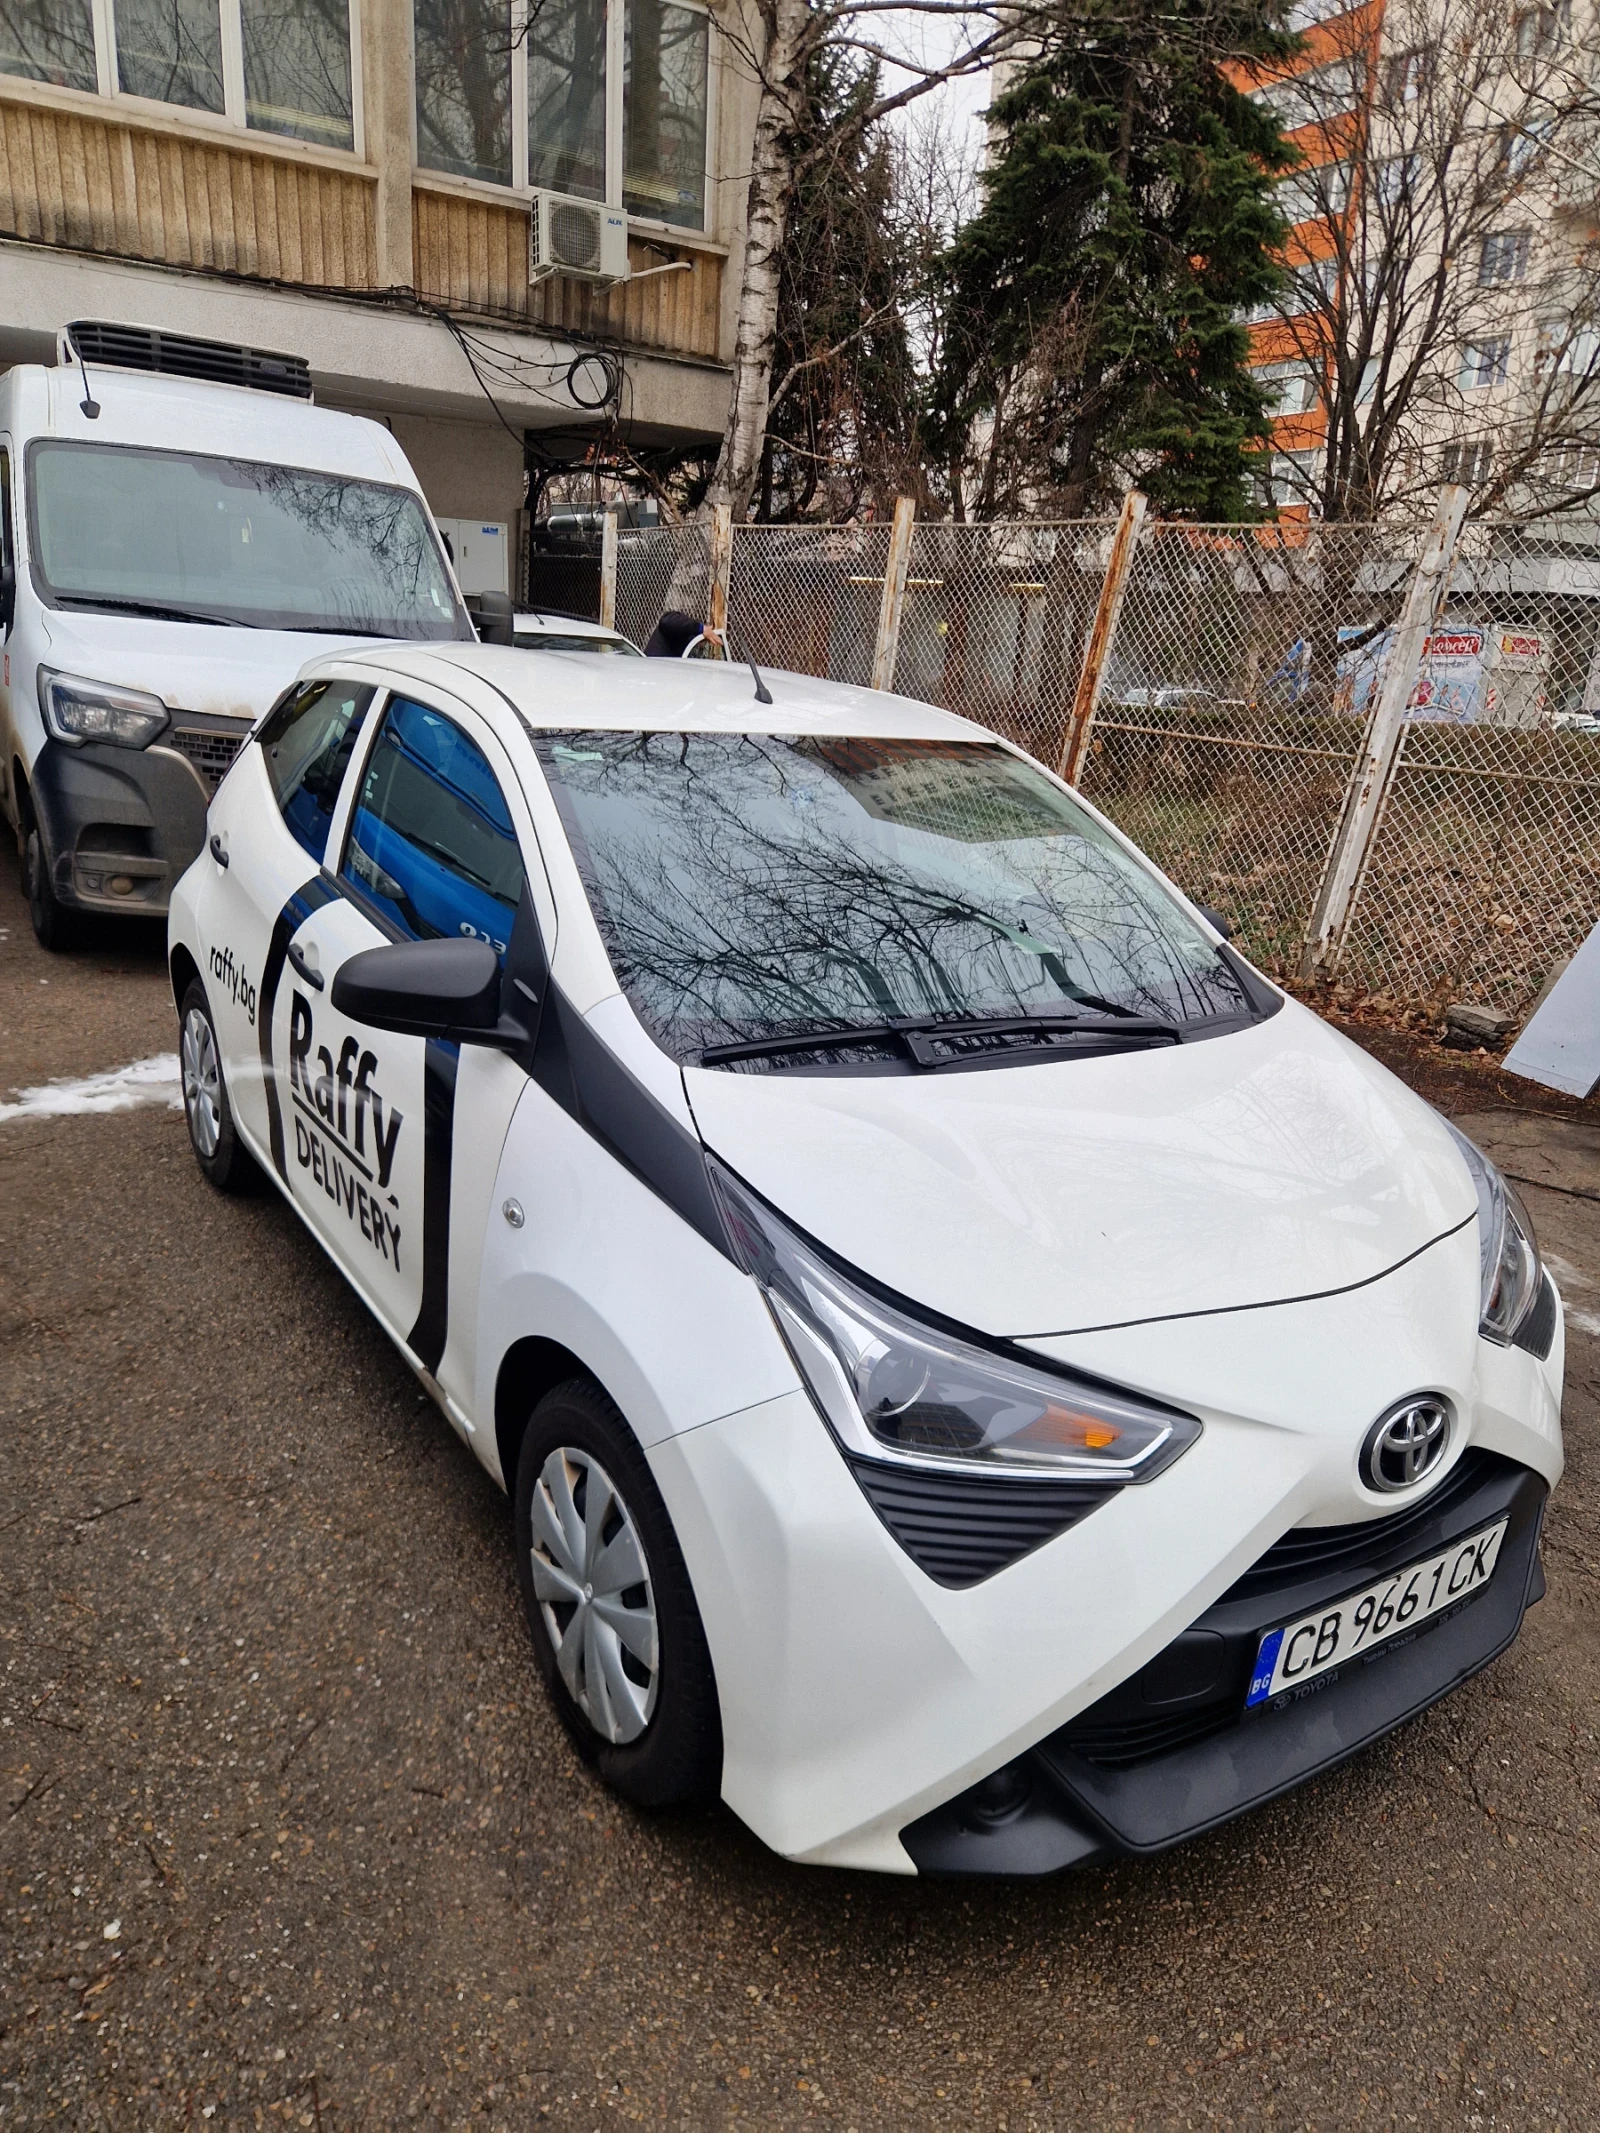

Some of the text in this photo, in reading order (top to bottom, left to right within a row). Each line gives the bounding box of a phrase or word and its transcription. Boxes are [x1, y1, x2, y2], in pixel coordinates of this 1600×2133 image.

[209, 945, 256, 1026] raffy.bg
[289, 988, 404, 1188] Raffy
[294, 1114, 401, 1273] DELIVERY
[1281, 1611, 1343, 1679] CB
[1351, 1560, 1446, 1649] 9661
[1447, 1530, 1498, 1595] CK
[1251, 1673, 1271, 1695] BG
[1294, 1671, 1339, 1701] TOYOTA
